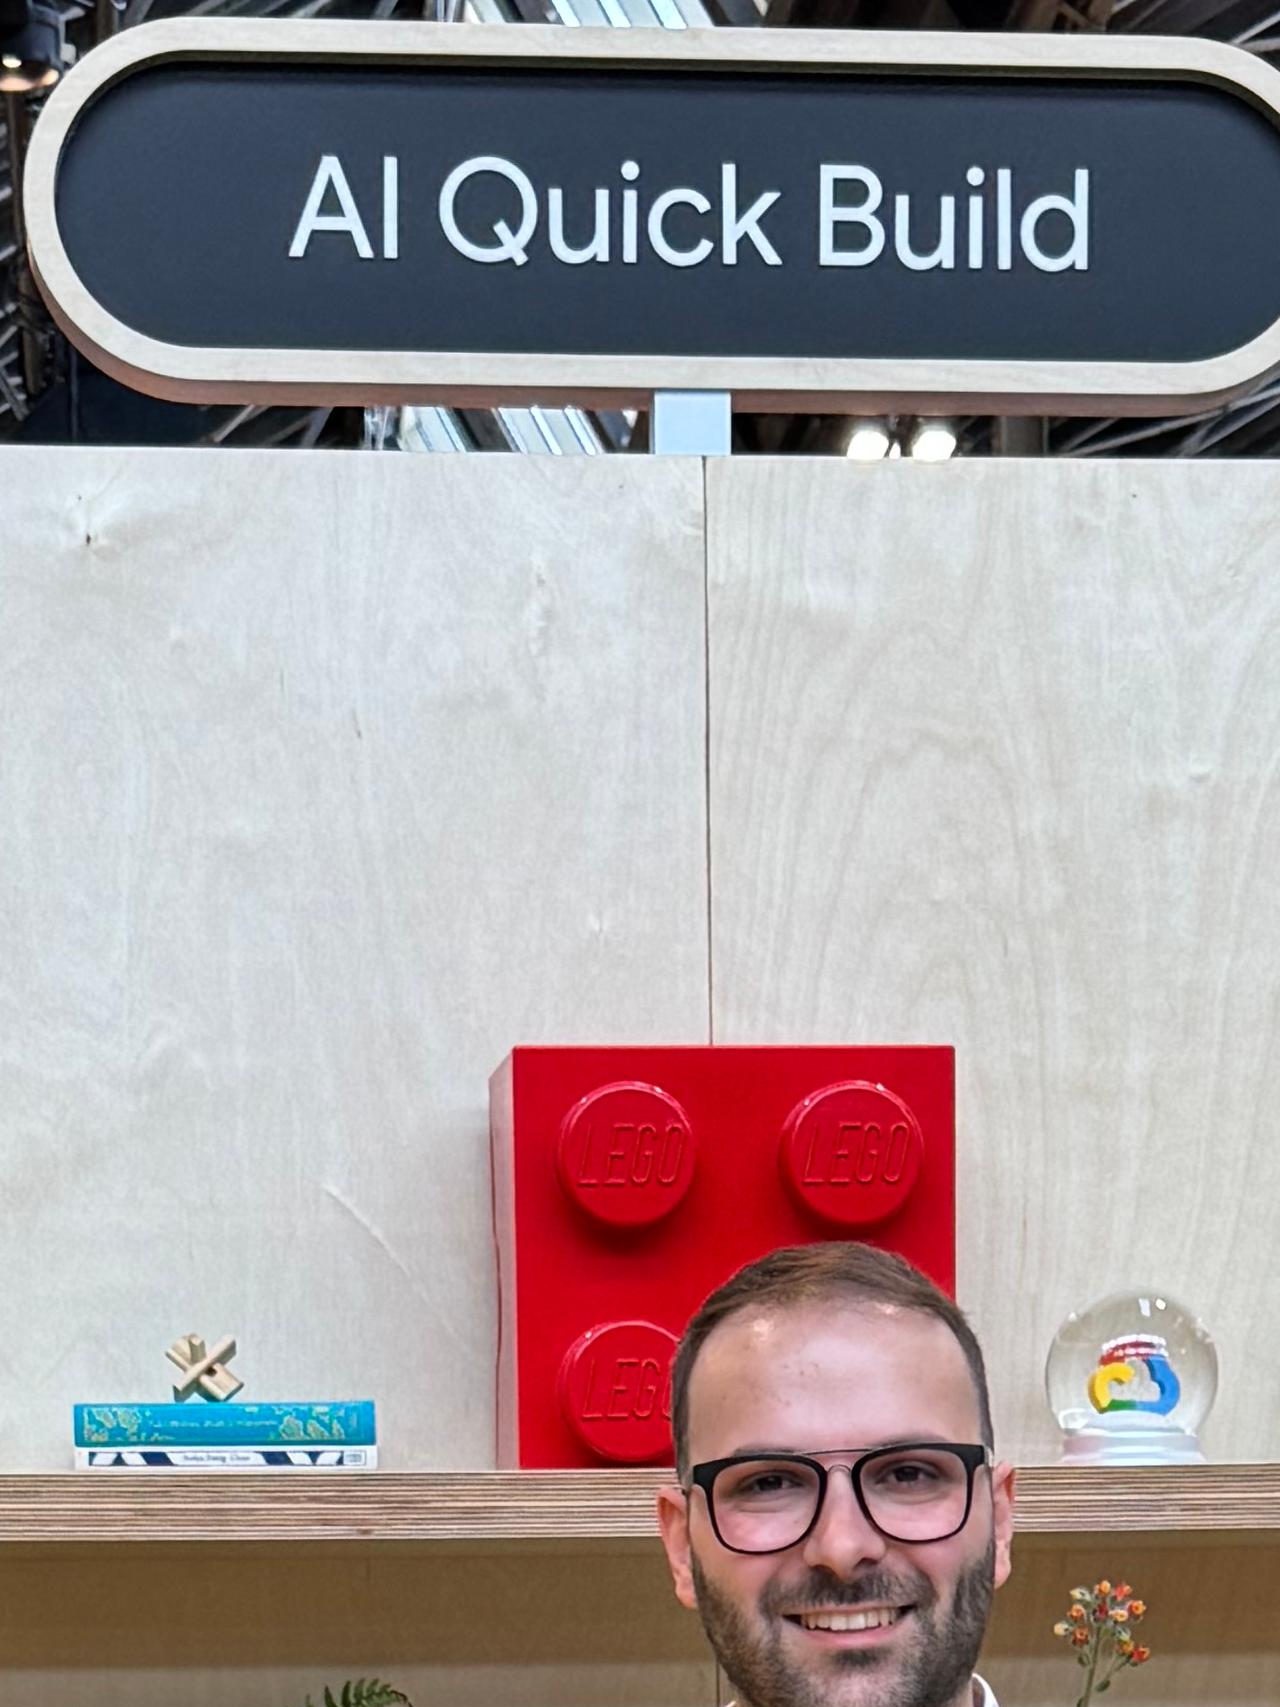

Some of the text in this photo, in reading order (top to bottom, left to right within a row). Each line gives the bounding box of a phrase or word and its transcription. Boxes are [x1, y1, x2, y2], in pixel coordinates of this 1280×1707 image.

[288, 154, 1091, 273] AI Quick Build
[576, 1122, 685, 1188] LEGO
[801, 1120, 911, 1187] LEGO
